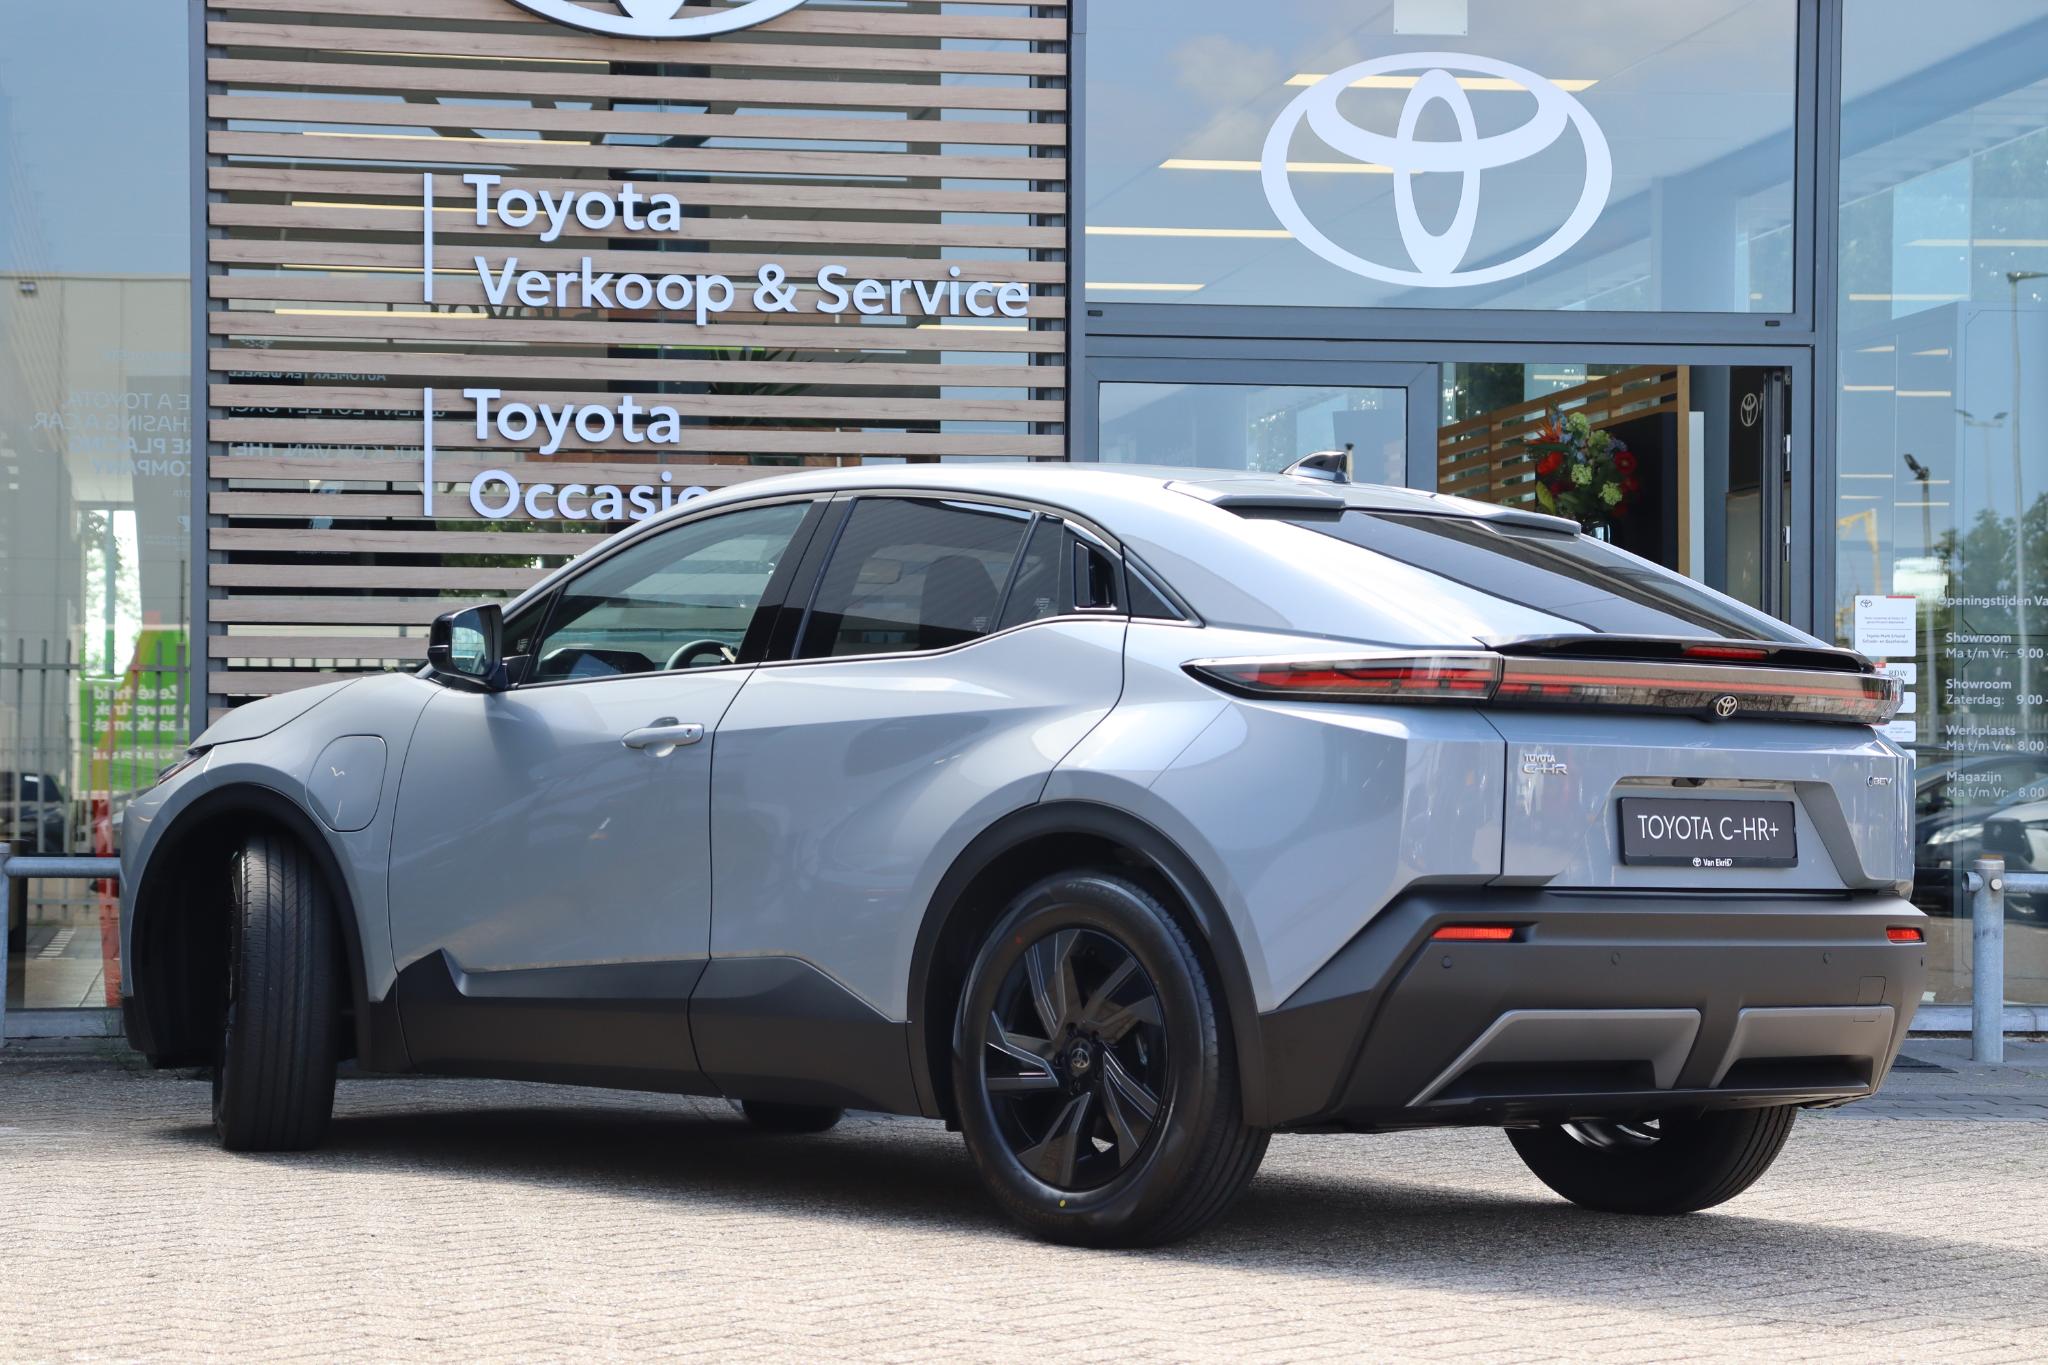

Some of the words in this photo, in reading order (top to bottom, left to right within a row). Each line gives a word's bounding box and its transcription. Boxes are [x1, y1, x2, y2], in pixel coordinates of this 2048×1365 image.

[463, 173, 681, 242] Toyota
[473, 256, 735, 326] Verkoop
[752, 263, 798, 313] &
[816, 264, 1030, 318] Service
[463, 388, 681, 455] Toyota
[1937, 595, 2031, 608] Openingstijden
[1945, 632, 2012, 643] Showroom
[1946, 648, 1963, 658] Ma
[1967, 648, 1989, 661] t/m
[1992, 648, 2009, 659] Vr:
[2017, 648, 2044, 659] 9.00
[1945, 678, 2012, 689] Showroom
[1946, 694, 2005, 707] Zaterdag:
[2016, 694, 2043, 705] 9.00
[1946, 725, 2016, 738] Werkplaats
[1946, 741, 1965, 751] Ma
[1968, 741, 1989, 752] t/m
[2017, 741, 2044, 752] 8.00
[1524, 753, 1556, 763] TOYOTA
[1946, 771, 2002, 784] Magazijn
[1946, 787, 1965, 797] Ma
[1968, 787, 1990, 799] t/m
[2018, 787, 2045, 797] 8.00
[1636, 814, 1714, 841] TOYOTA
[1719, 816, 1780, 842] C-HR+
[1702, 858, 1715, 867] Van
